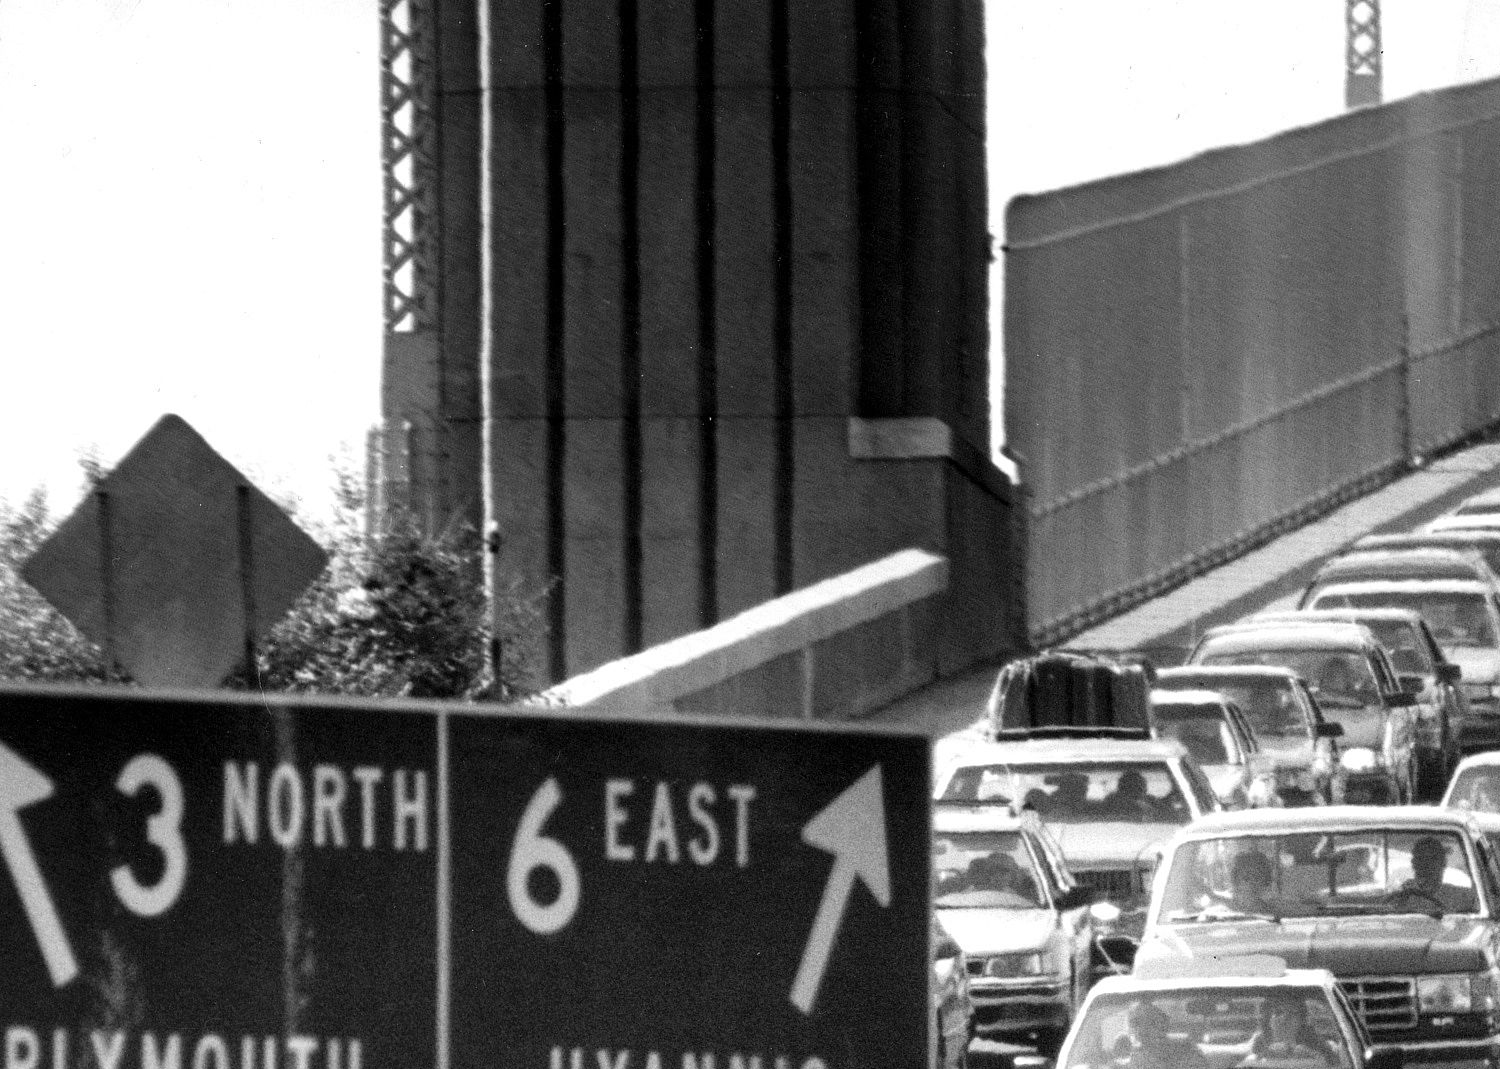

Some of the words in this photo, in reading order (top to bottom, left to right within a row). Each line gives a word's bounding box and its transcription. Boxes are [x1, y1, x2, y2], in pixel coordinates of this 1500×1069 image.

[110, 754, 187, 918] 3
[224, 761, 429, 852] NORTH
[506, 778, 582, 935] 6
[605, 780, 757, 867] EAST
